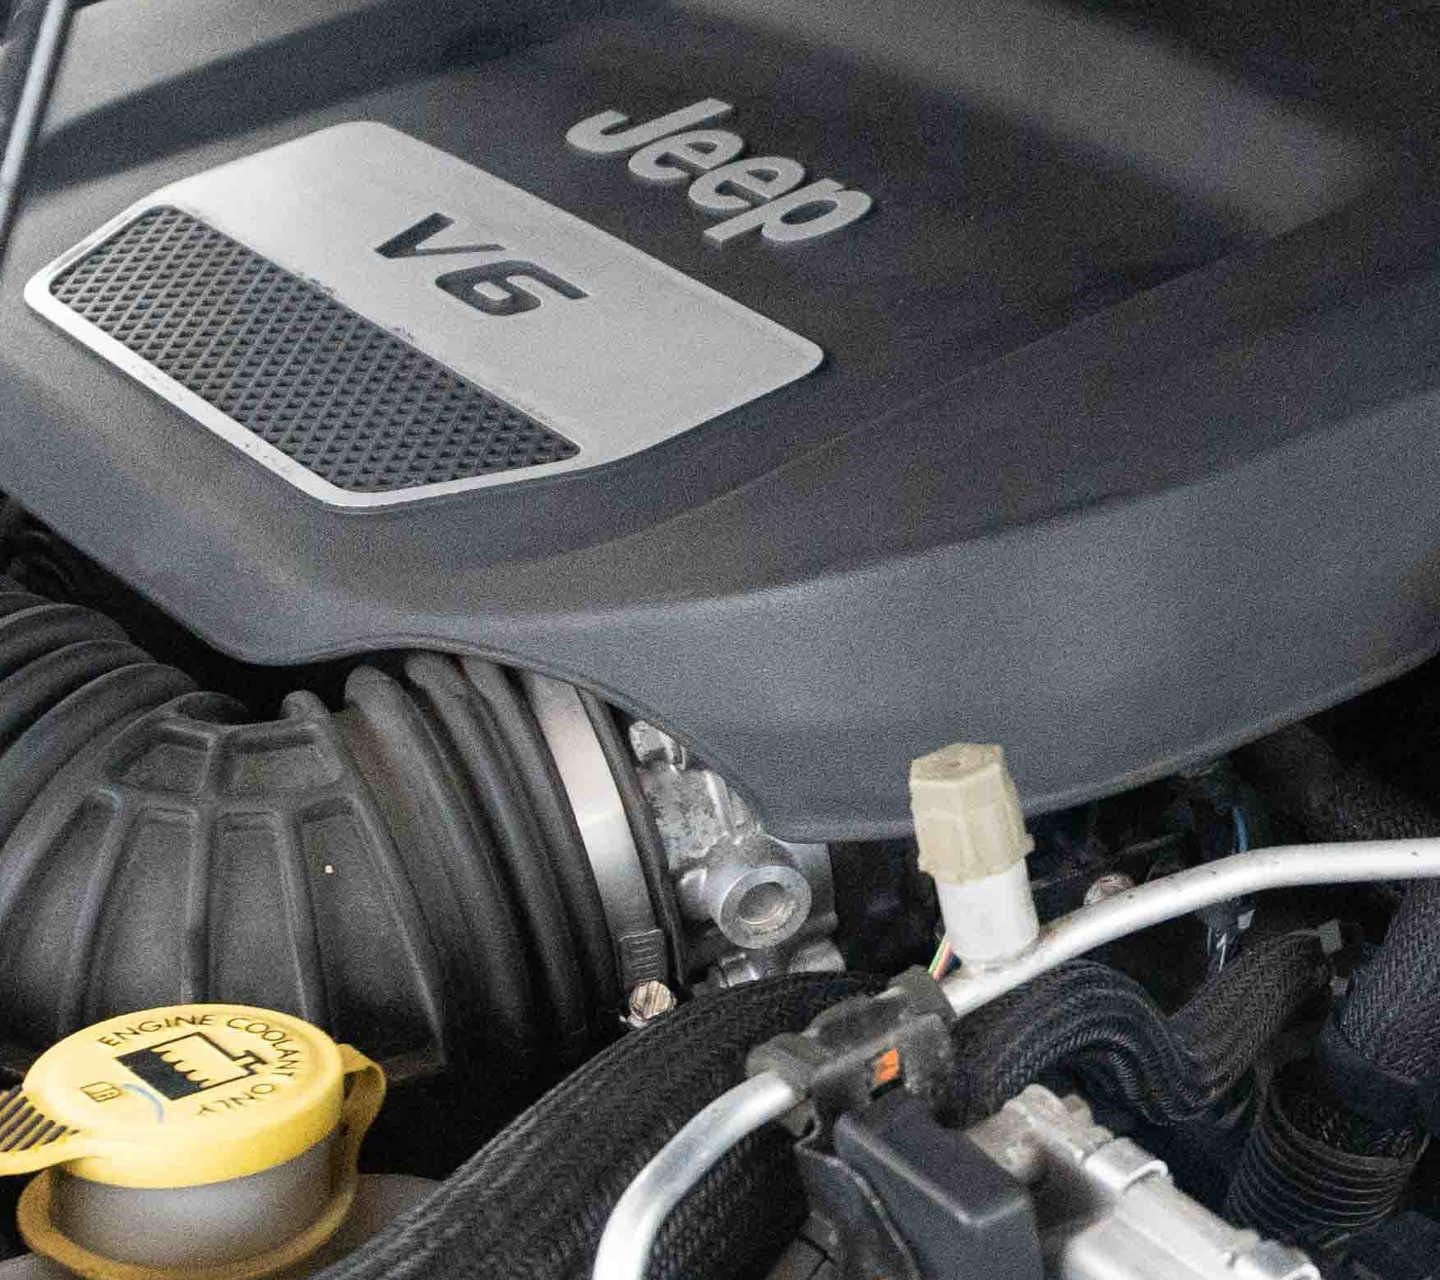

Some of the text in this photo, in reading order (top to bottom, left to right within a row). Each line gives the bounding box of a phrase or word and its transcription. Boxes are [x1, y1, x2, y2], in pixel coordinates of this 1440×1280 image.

[565, 97, 874, 248] Jeep
[373, 211, 589, 317] V6
[97, 1013, 302, 1119] ENGINE COOLANT ONLY
